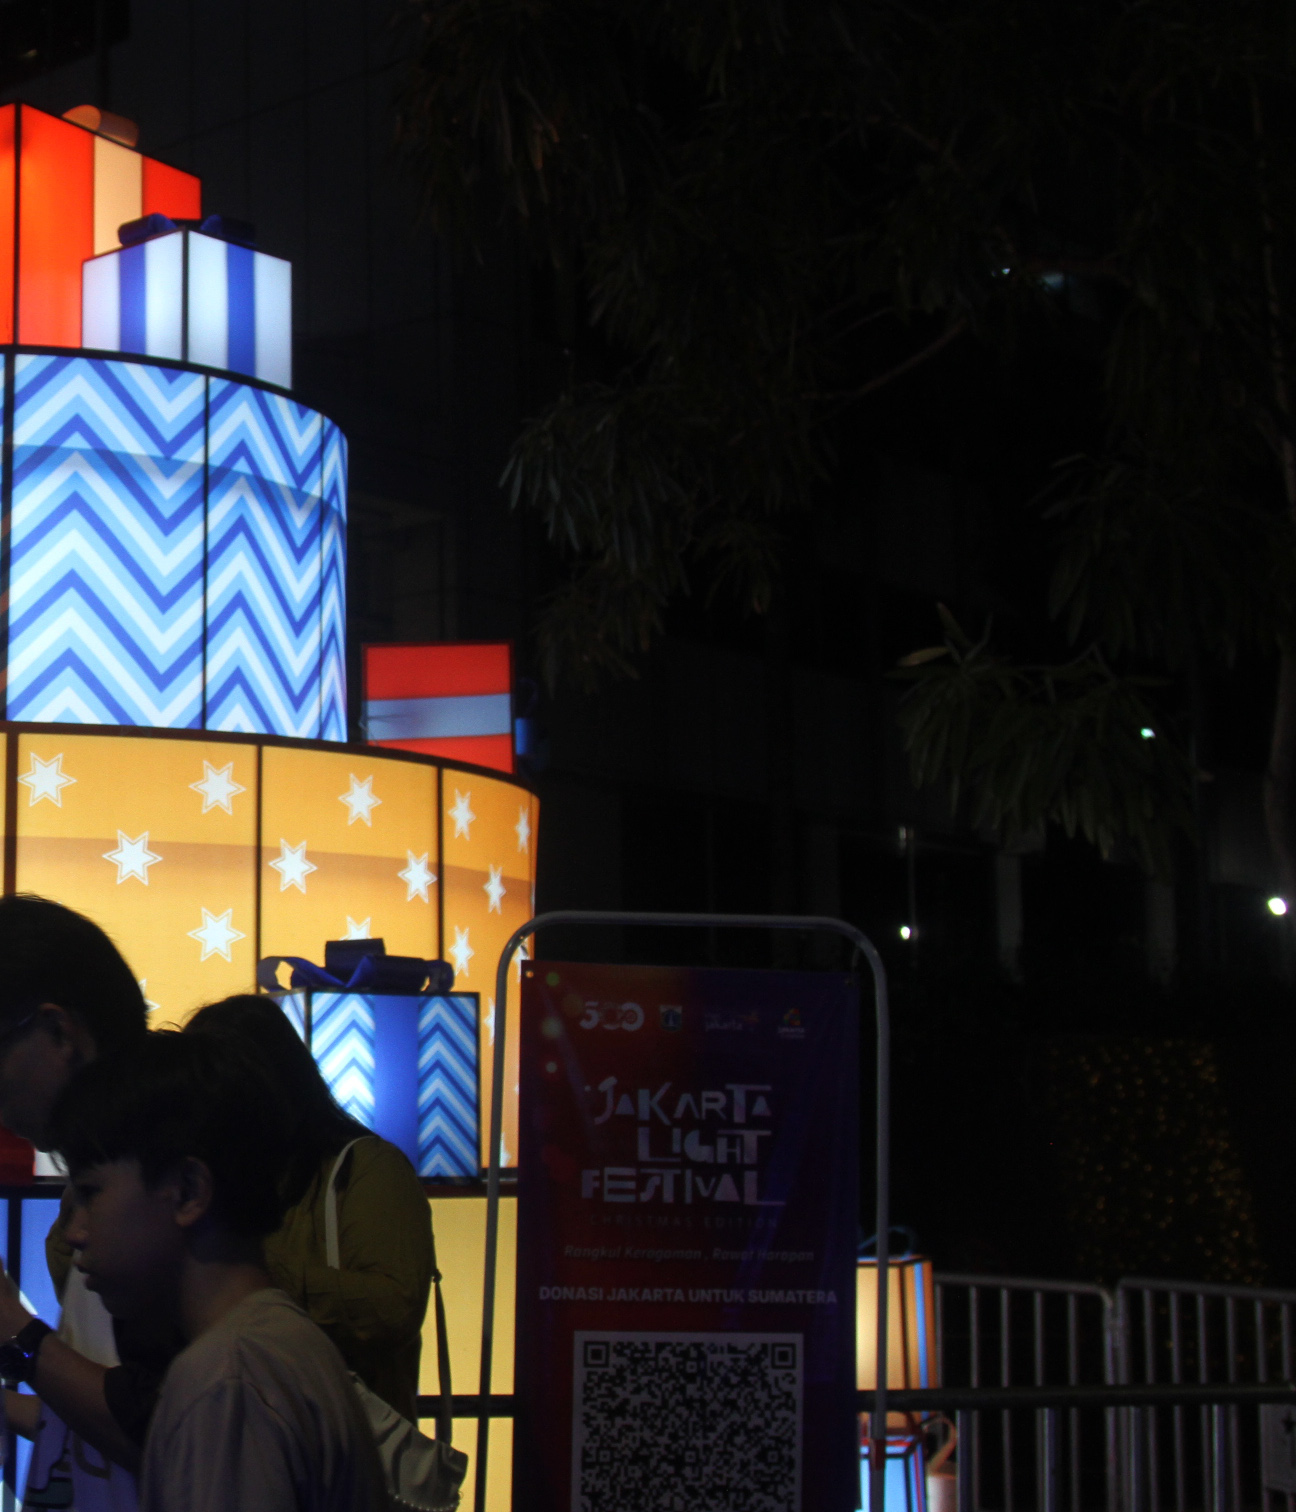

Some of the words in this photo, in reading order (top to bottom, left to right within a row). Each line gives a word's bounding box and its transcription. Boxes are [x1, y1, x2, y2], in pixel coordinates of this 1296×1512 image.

[594, 1075, 772, 1126] JAKARTA
[637, 1126, 772, 1164] LIGHT
[581, 1166, 787, 1206] FESTIVAL
[590, 1214, 693, 1229] CHRISTMAS
[564, 1245, 621, 1261] Rangkul
[539, 1286, 604, 1301] DONASI
[606, 1287, 685, 1302] JAKARTA
[688, 1289, 745, 1303] UNTUK
[748, 1289, 838, 1304] SUMATERA
